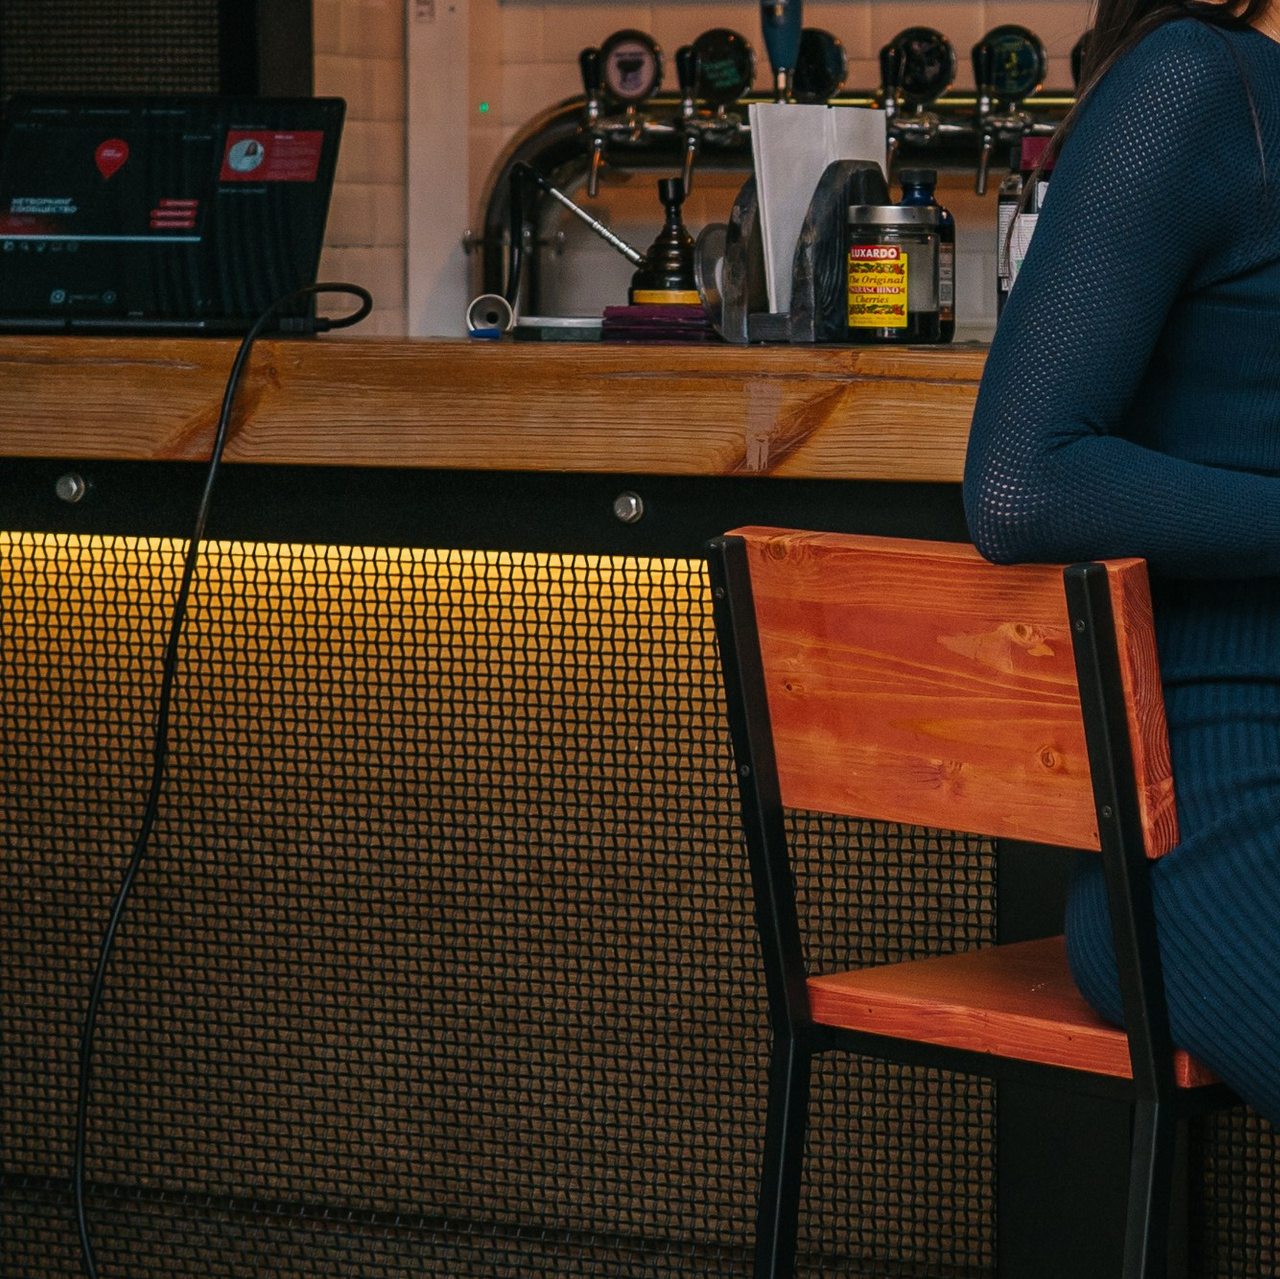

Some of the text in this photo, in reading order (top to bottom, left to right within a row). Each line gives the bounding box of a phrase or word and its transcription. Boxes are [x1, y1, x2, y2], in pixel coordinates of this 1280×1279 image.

[851, 248, 898, 259] LUXARDO
[861, 275, 904, 286] Original
[855, 294, 889, 303] Cherries
